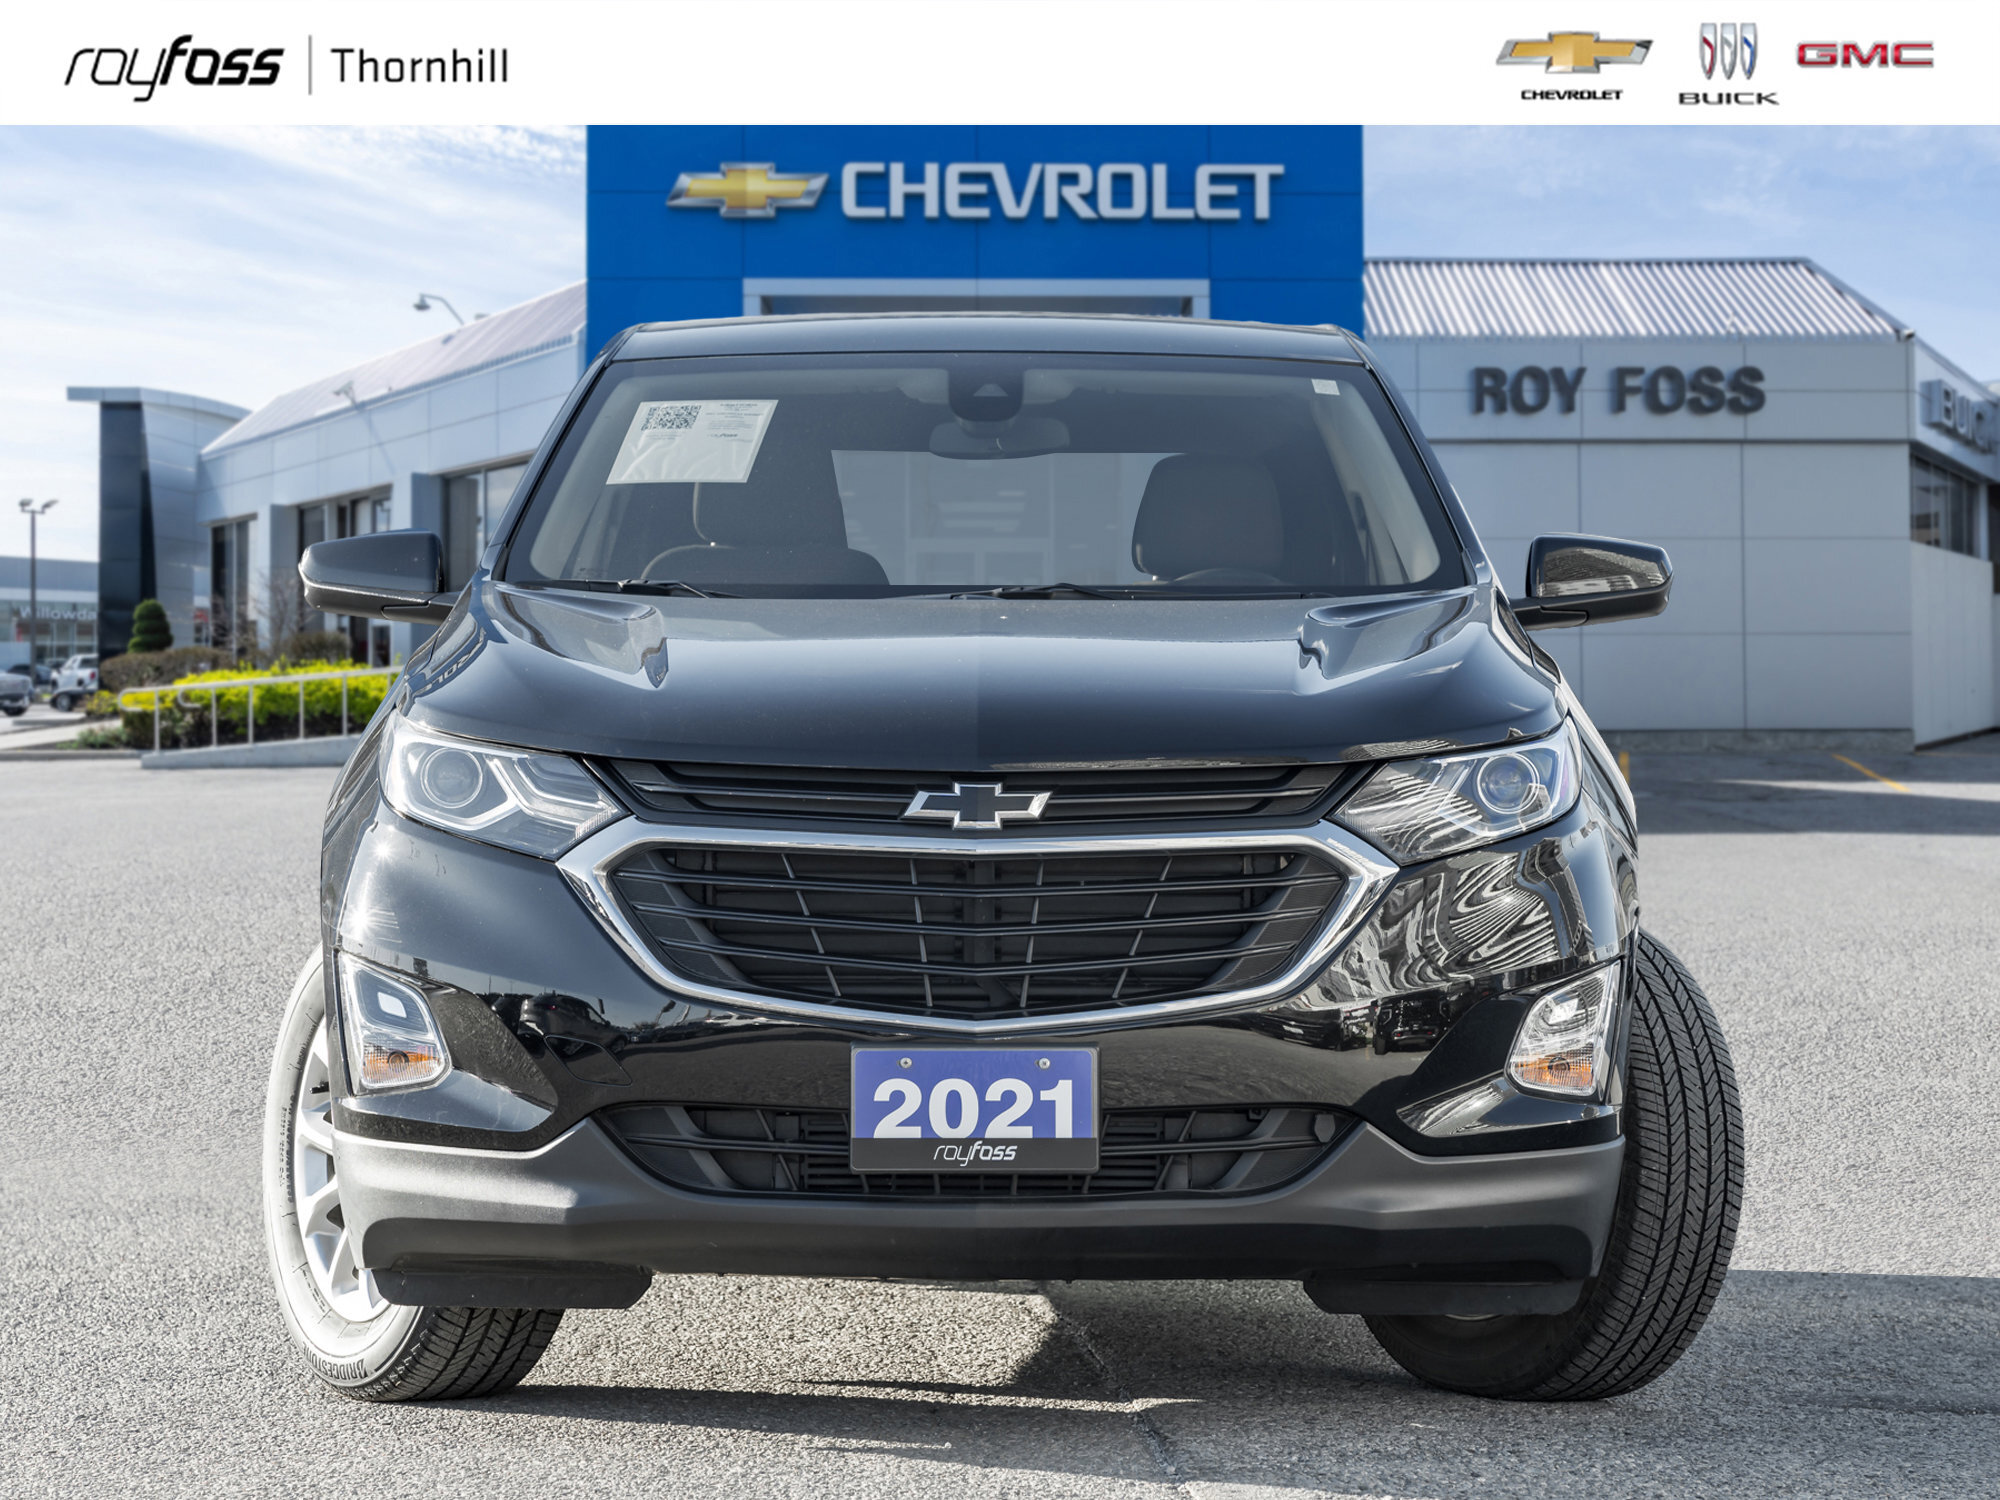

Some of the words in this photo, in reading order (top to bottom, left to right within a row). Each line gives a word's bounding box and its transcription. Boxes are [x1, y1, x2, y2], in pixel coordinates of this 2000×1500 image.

[841, 161, 1285, 221] CHEVROLET
[1470, 365, 1587, 416] ROY
[1611, 365, 1767, 416] FOSS
[872, 1077, 1074, 1139] 2021
